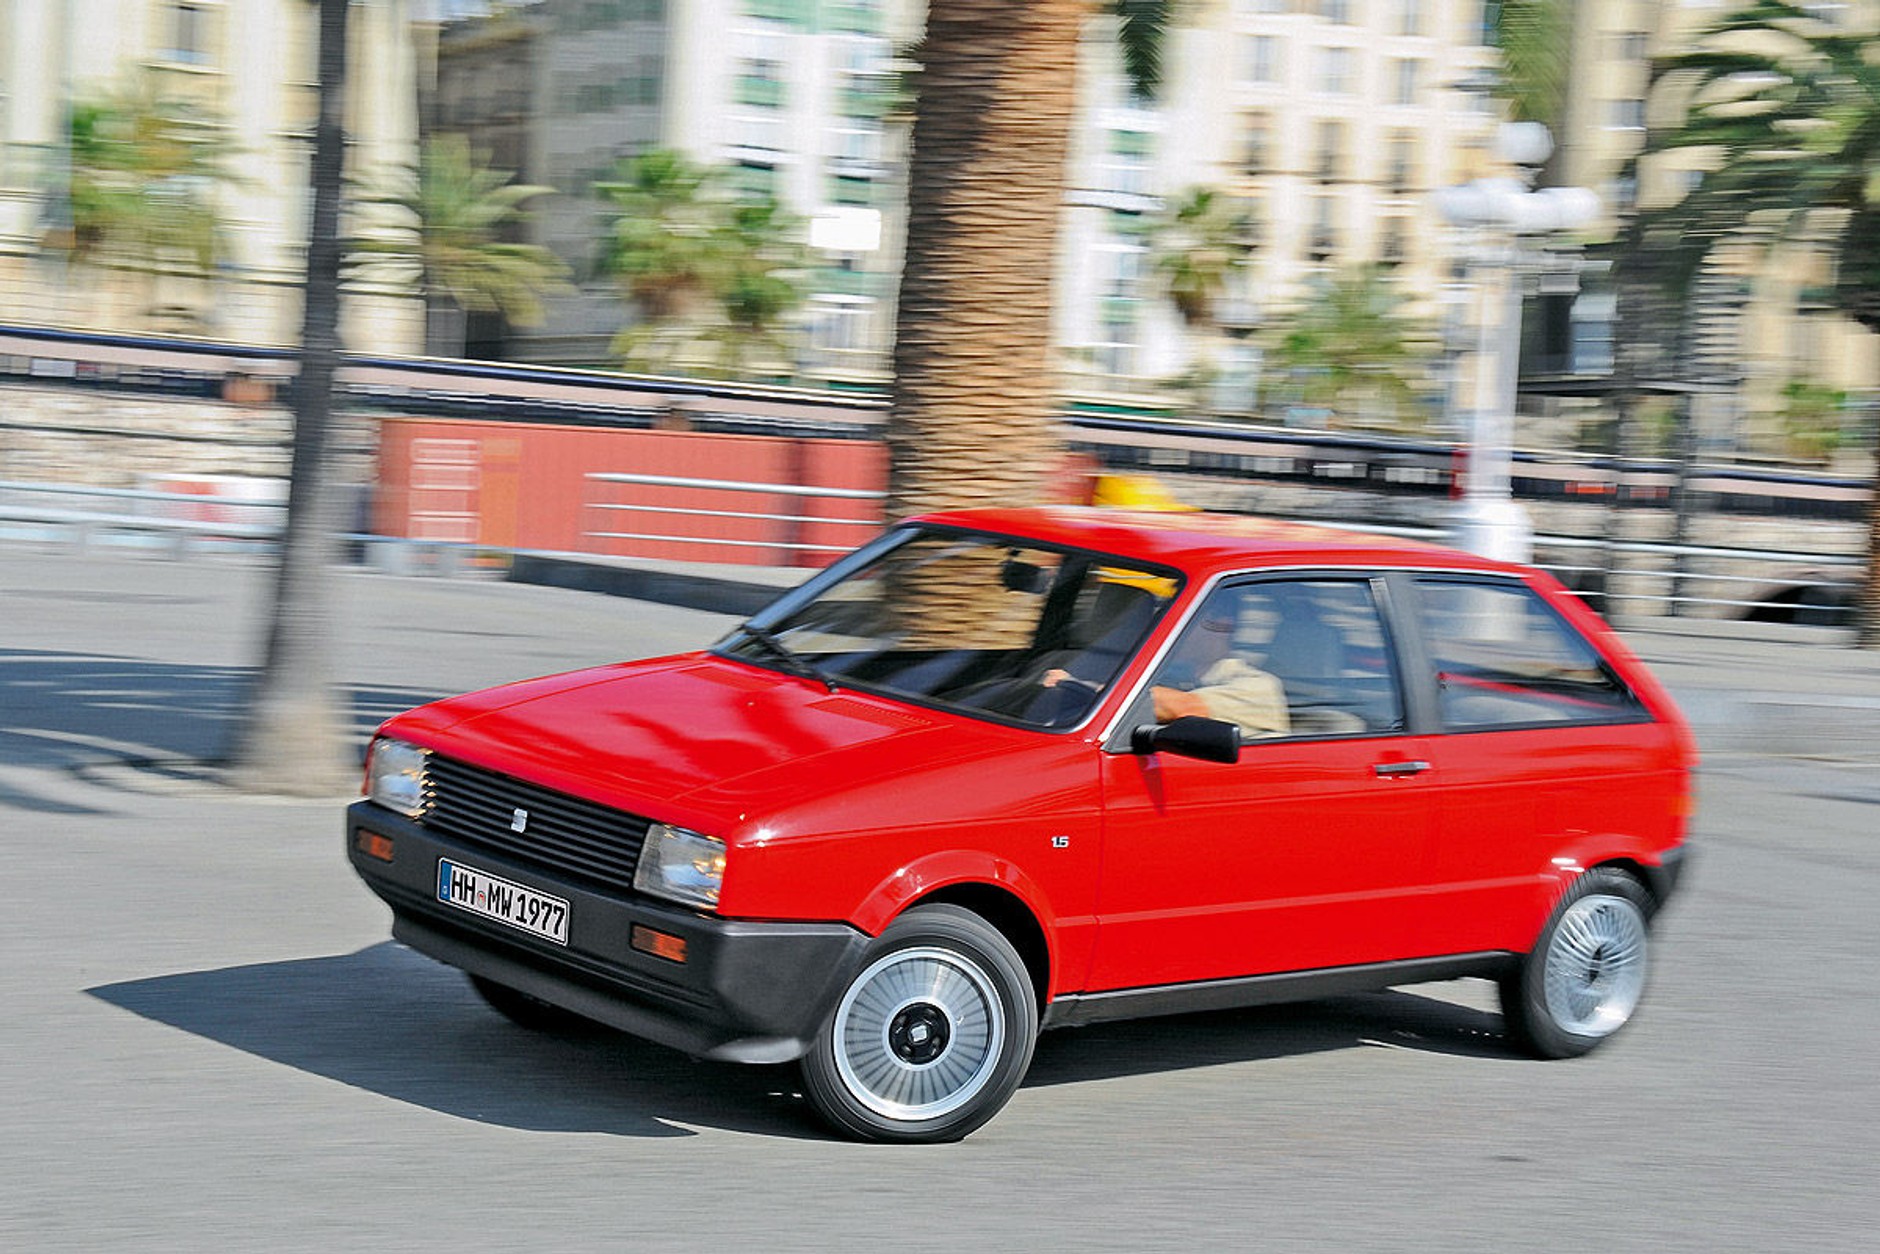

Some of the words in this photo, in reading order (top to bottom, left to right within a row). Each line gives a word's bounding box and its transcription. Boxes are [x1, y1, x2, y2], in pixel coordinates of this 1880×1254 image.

[451, 870, 476, 905] HH
[487, 883, 513, 918] MW
[515, 894, 565, 935] 1977
